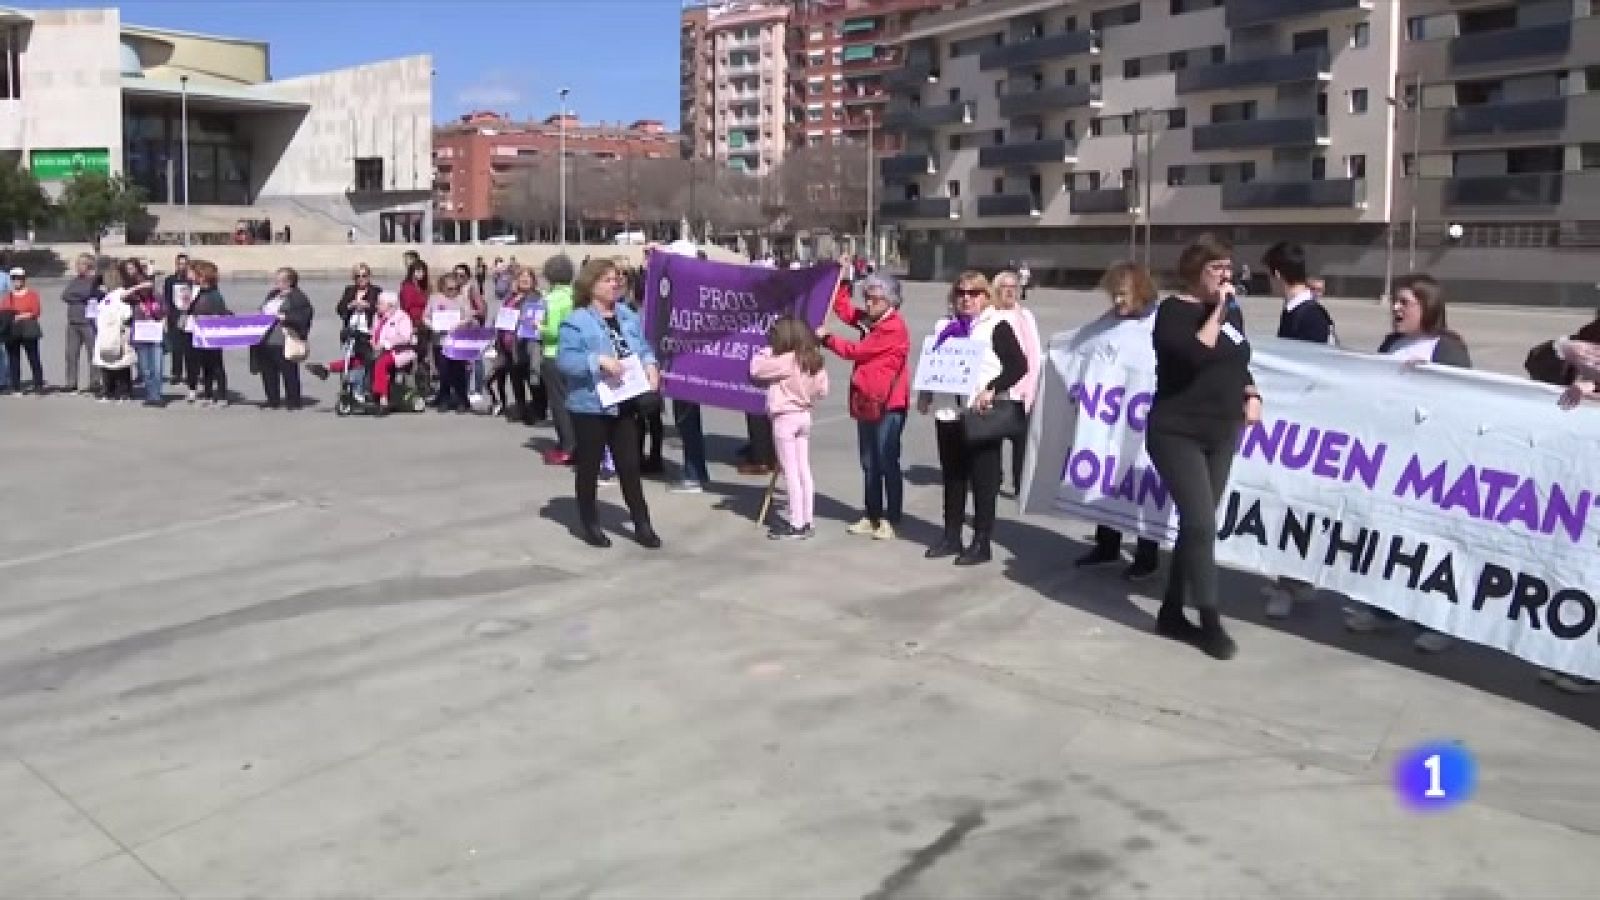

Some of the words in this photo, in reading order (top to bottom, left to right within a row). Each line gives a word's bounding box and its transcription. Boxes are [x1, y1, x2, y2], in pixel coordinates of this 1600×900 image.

[1393, 454, 1600, 542] MATAN
[1217, 491, 1267, 546] JA
[1383, 535, 1458, 603] HA
[1472, 562, 1600, 639] PRO
